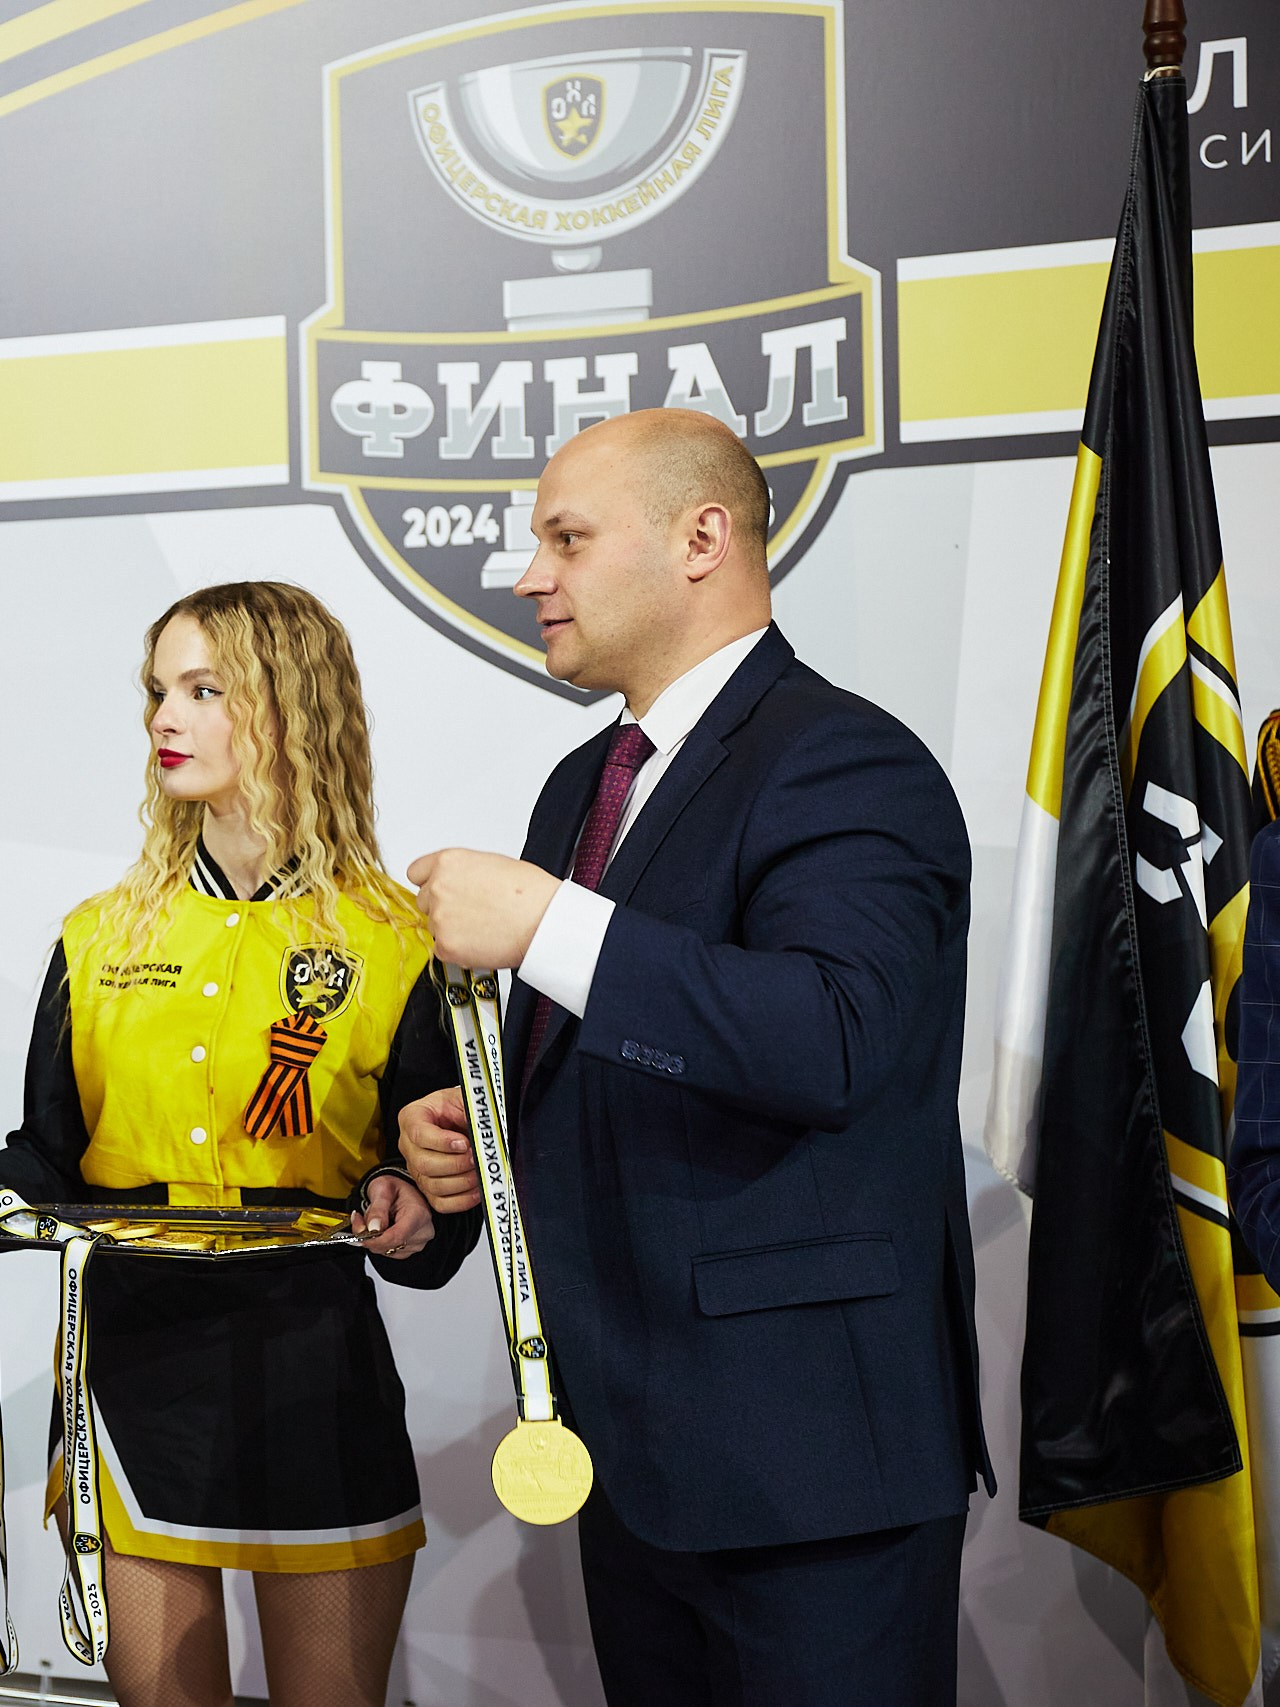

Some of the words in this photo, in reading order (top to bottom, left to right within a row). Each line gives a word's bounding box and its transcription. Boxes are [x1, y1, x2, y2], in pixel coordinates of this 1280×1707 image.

[422, 102, 548, 230] ОФИЦЕРСКАЯ
[554, 140, 703, 232] ХОККЕЙНАЯ
[695, 65, 735, 141] ЛИГА
[331, 316, 849, 460] ФИНАЛ
[402, 502, 501, 549] 2024
[464, 1038, 482, 1080] ЛИГА
[473, 1086, 503, 1185] ХОККЕЙНАЯ
[517, 1260, 530, 1303] ЛИГА
[64, 1267, 77, 1371] ОФИЦЕРСКАЯ
[87, 1583, 102, 1618] 2025
